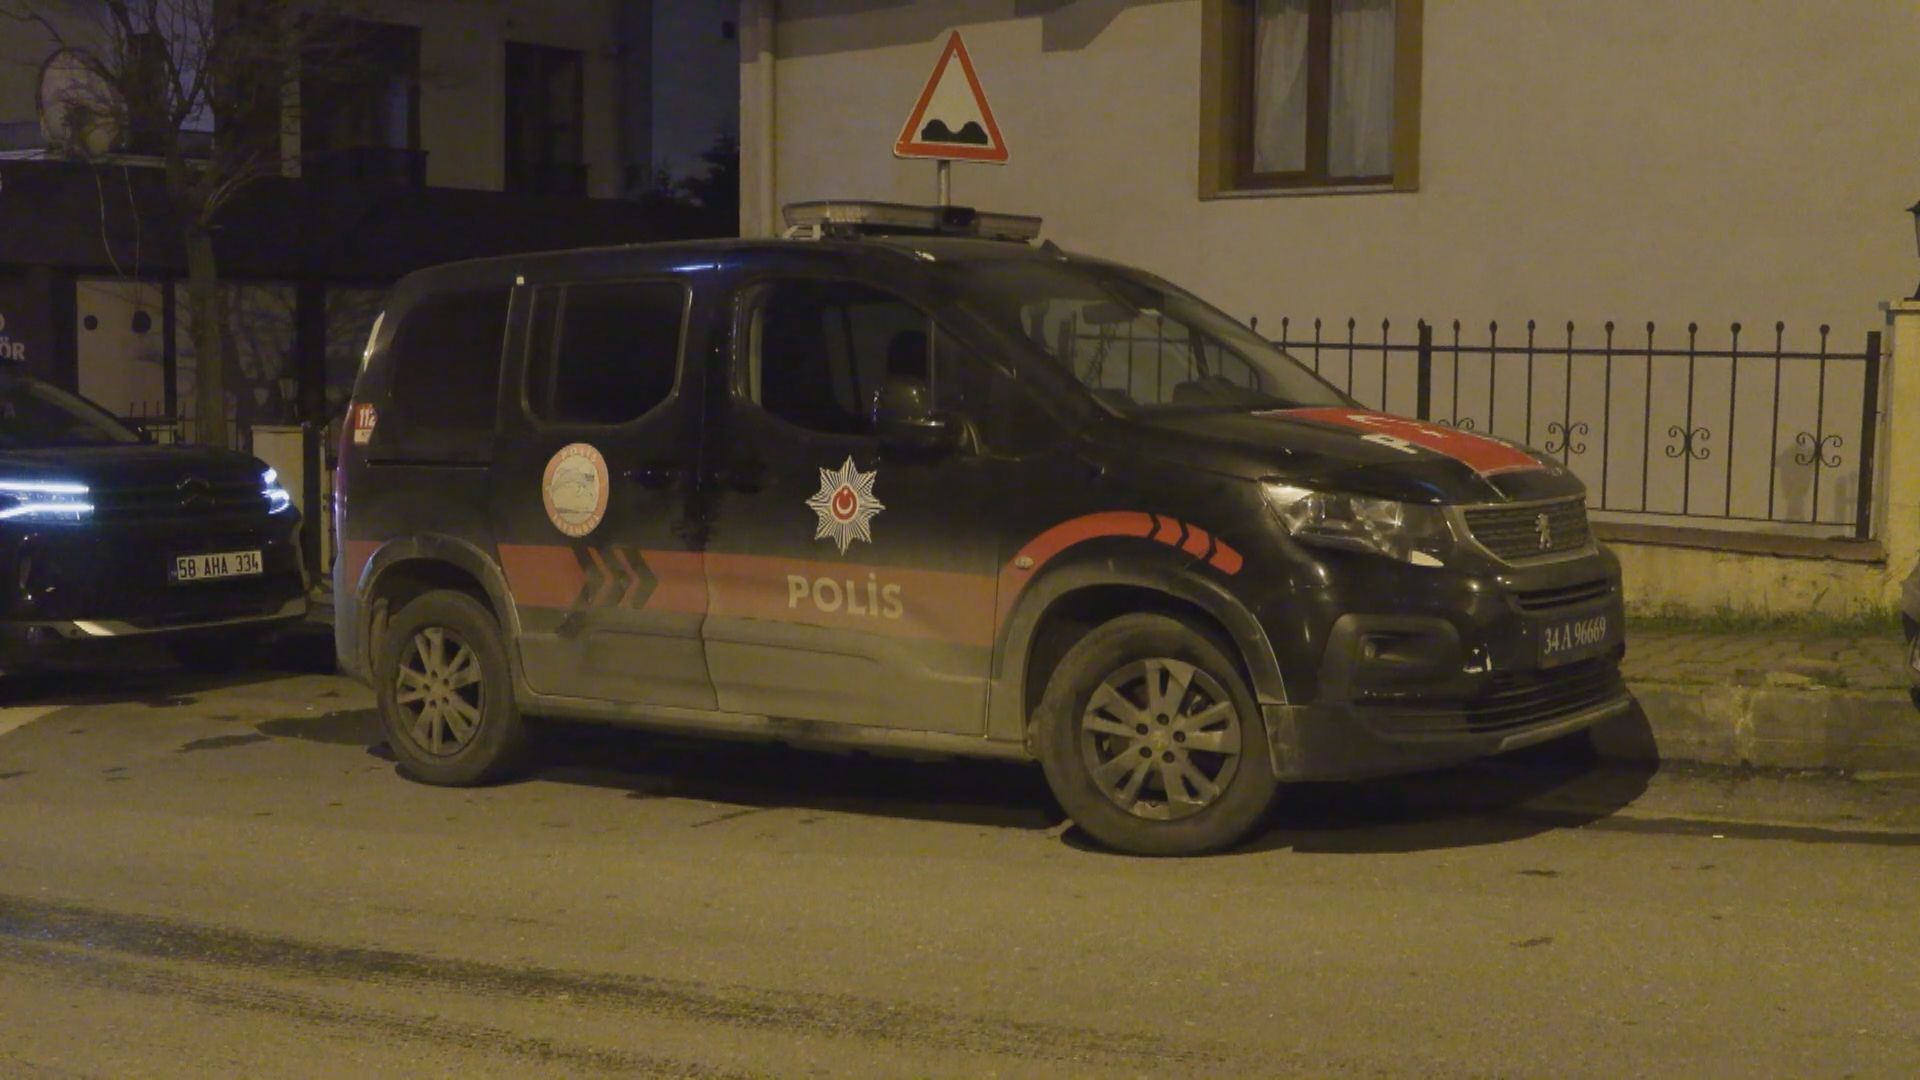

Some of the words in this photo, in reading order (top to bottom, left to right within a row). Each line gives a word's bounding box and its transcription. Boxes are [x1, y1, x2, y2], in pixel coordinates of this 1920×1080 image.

[359, 407, 376, 428] 112
[178, 558, 197, 578] 58
[204, 555, 228, 577] AHA
[235, 552, 259, 572] 334
[786, 571, 904, 620] POLİS
[1543, 626, 1560, 656] 34
[1561, 622, 1573, 651] A
[1574, 615, 1607, 647] 96669
